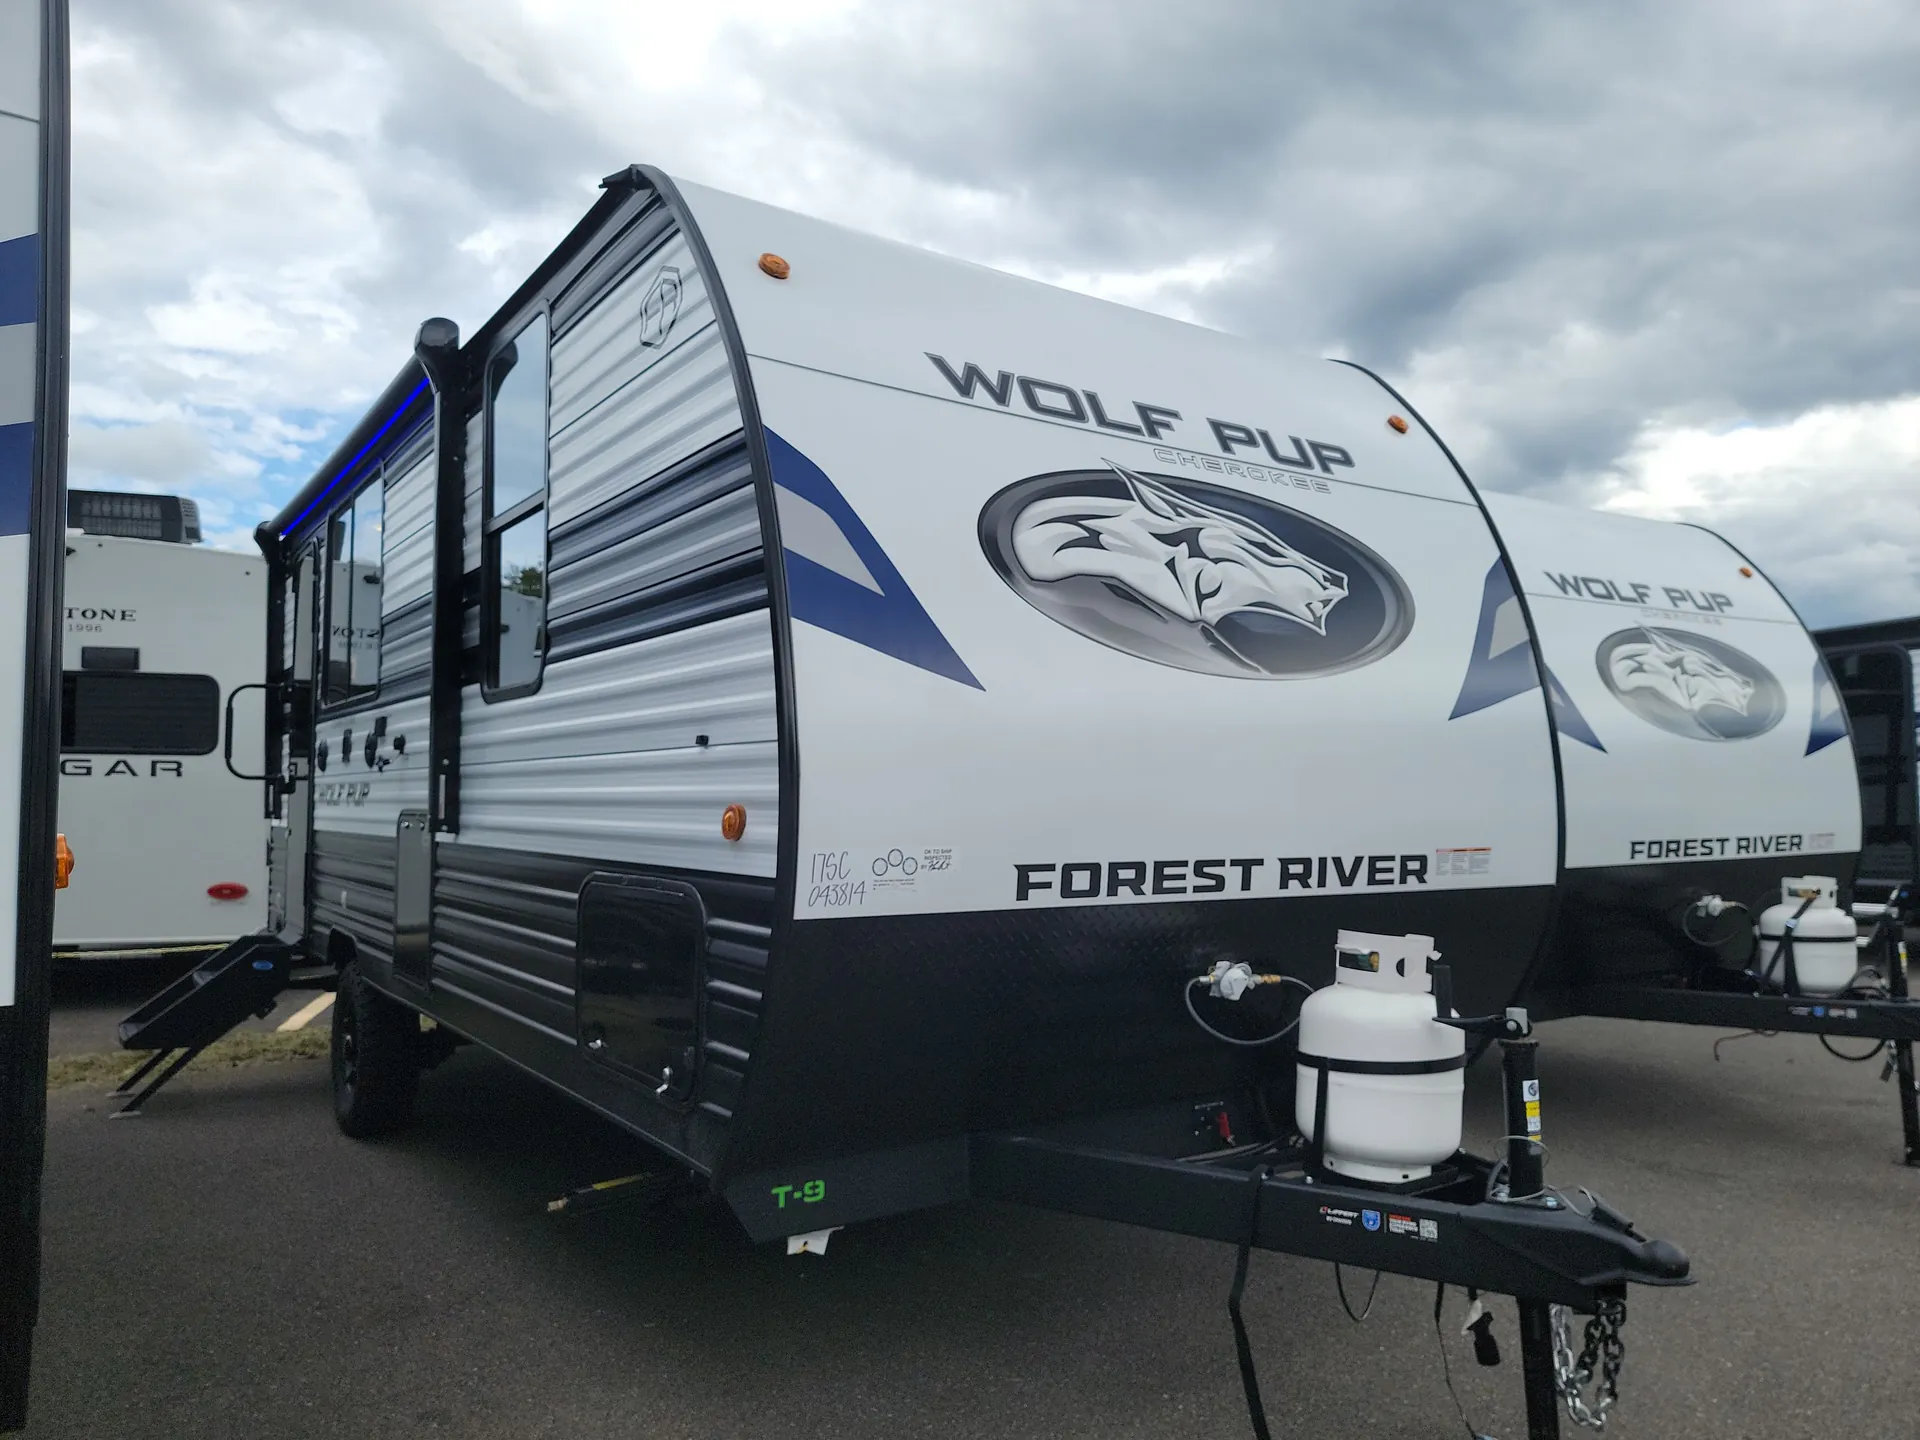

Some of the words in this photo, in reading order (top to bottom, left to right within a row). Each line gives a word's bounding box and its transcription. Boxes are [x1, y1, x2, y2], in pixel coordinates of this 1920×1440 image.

[923, 351, 1183, 440] WOLF
[1206, 416, 1356, 475] PUP
[1152, 447, 1332, 494] CHEROKEE
[1543, 571, 1651, 605] WOLF
[1661, 586, 1734, 614] PUP
[67, 623, 103, 633] 1996
[60, 758, 183, 778] GAR
[1629, 838, 1730, 860] FOREST
[1735, 834, 1804, 854] RIVER
[1013, 858, 1265, 902] FOREST
[1276, 854, 1429, 891] RIVER
[808, 880, 868, 907] 043814
[771, 1179, 826, 1208] T-9
